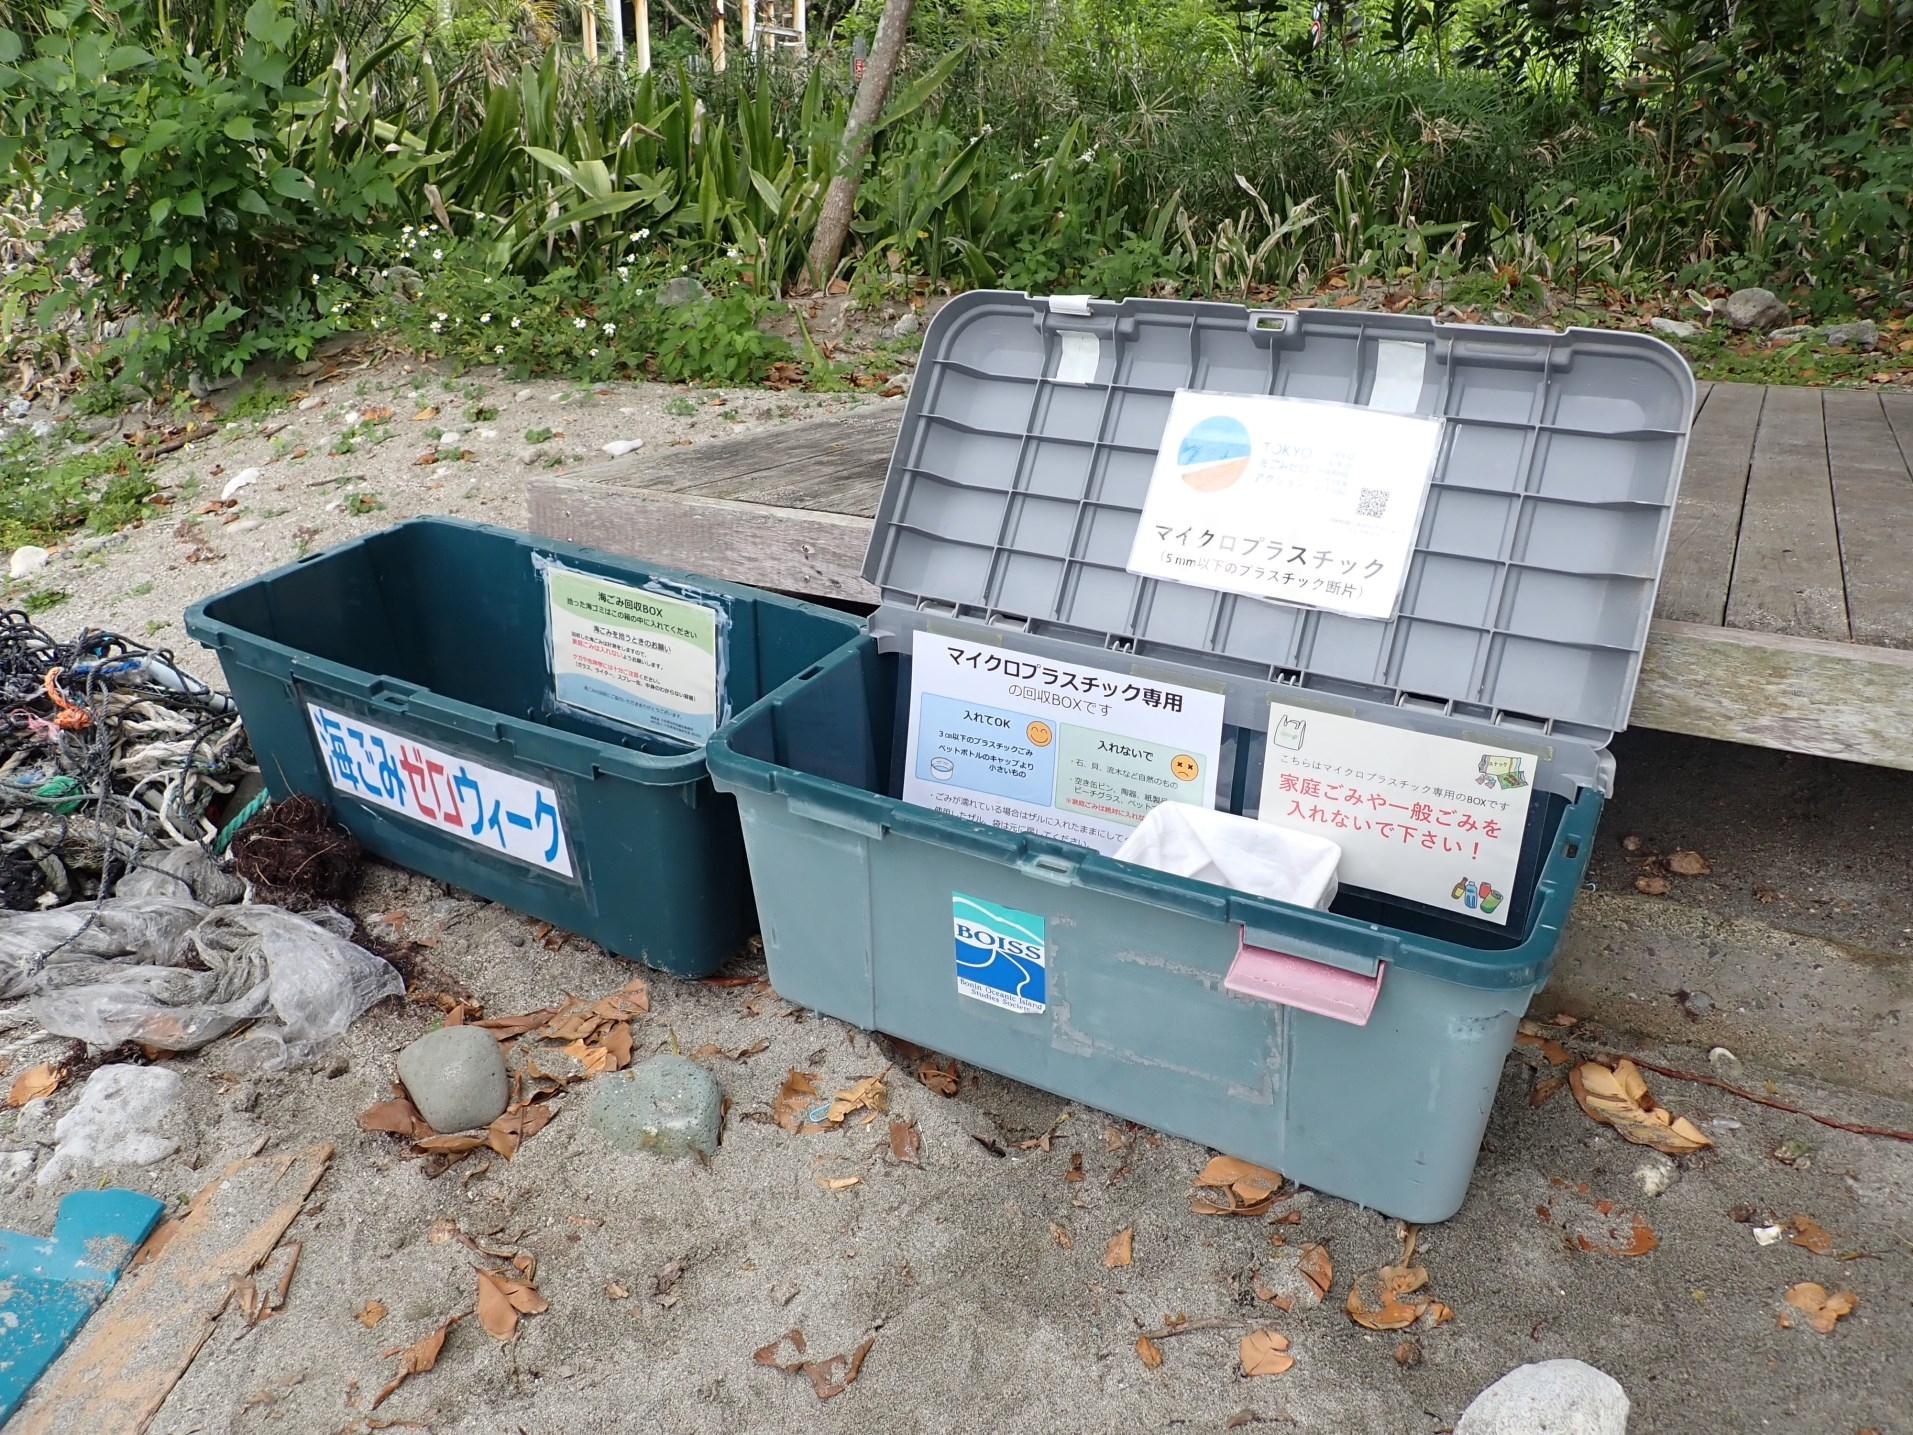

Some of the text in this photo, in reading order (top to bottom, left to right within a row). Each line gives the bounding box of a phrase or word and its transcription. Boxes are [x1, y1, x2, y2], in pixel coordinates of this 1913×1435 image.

[1264, 442, 1313, 459] TOKYO
[1154, 525, 1385, 580] マイクロプラスチック
[566, 597, 698, 639] 拾った海ゴミはこの箱の中に入れてください
[597, 591, 663, 618] 海ごみ回収BOX
[946, 646, 1184, 713] マイクロプラスチック専用
[1008, 683, 1113, 717] の回収BOXです
[963, 710, 1011, 729] 入れてOK
[938, 744, 1034, 771] ペットボトルのキャップより
[1097, 740, 1154, 763] 入れないで
[314, 708, 559, 863] 海ごみゼロウィーク
[988, 763, 1027, 778] 小さいもの
[1279, 753, 1511, 812] こちらはマイクロプラスチック専用のBOXです
[1279, 773, 1503, 839] 家庭ごみや一般ごみを
[1286, 800, 1481, 861] 入れないで下さい！
[956, 923, 1041, 960] BOISS
[960, 978, 1043, 1011] Bonin Oceanic Island
[971, 988, 1000, 1003] Studies
